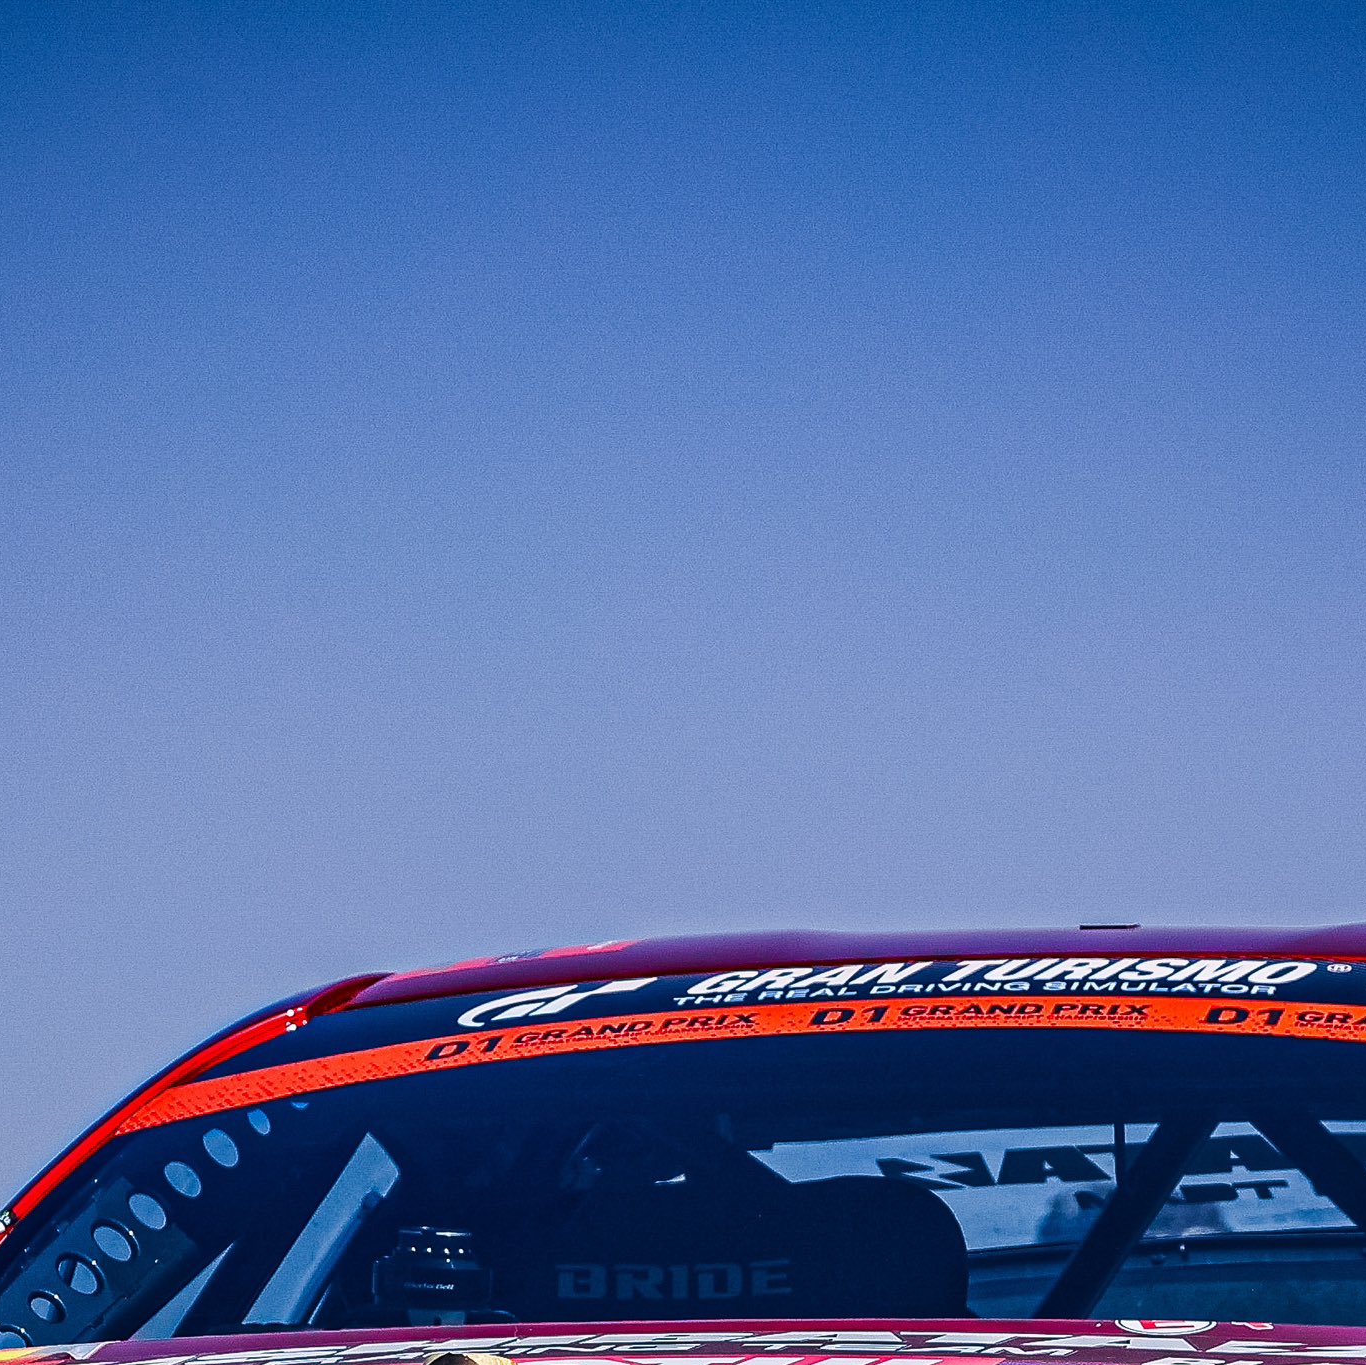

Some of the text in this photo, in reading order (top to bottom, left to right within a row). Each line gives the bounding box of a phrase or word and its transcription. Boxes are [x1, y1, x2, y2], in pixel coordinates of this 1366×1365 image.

[687, 957, 1317, 994] GRAN TURISMO
[673, 980, 1277, 1006] THE REAL DRIVING SIMULATOR
[810, 1003, 1151, 1026] D1 GRAND PRIX
[1204, 1006, 1285, 1027] D1
[424, 1011, 761, 1062] D1 GRAND PRIX
[555, 1259, 792, 1300] BRIDE
